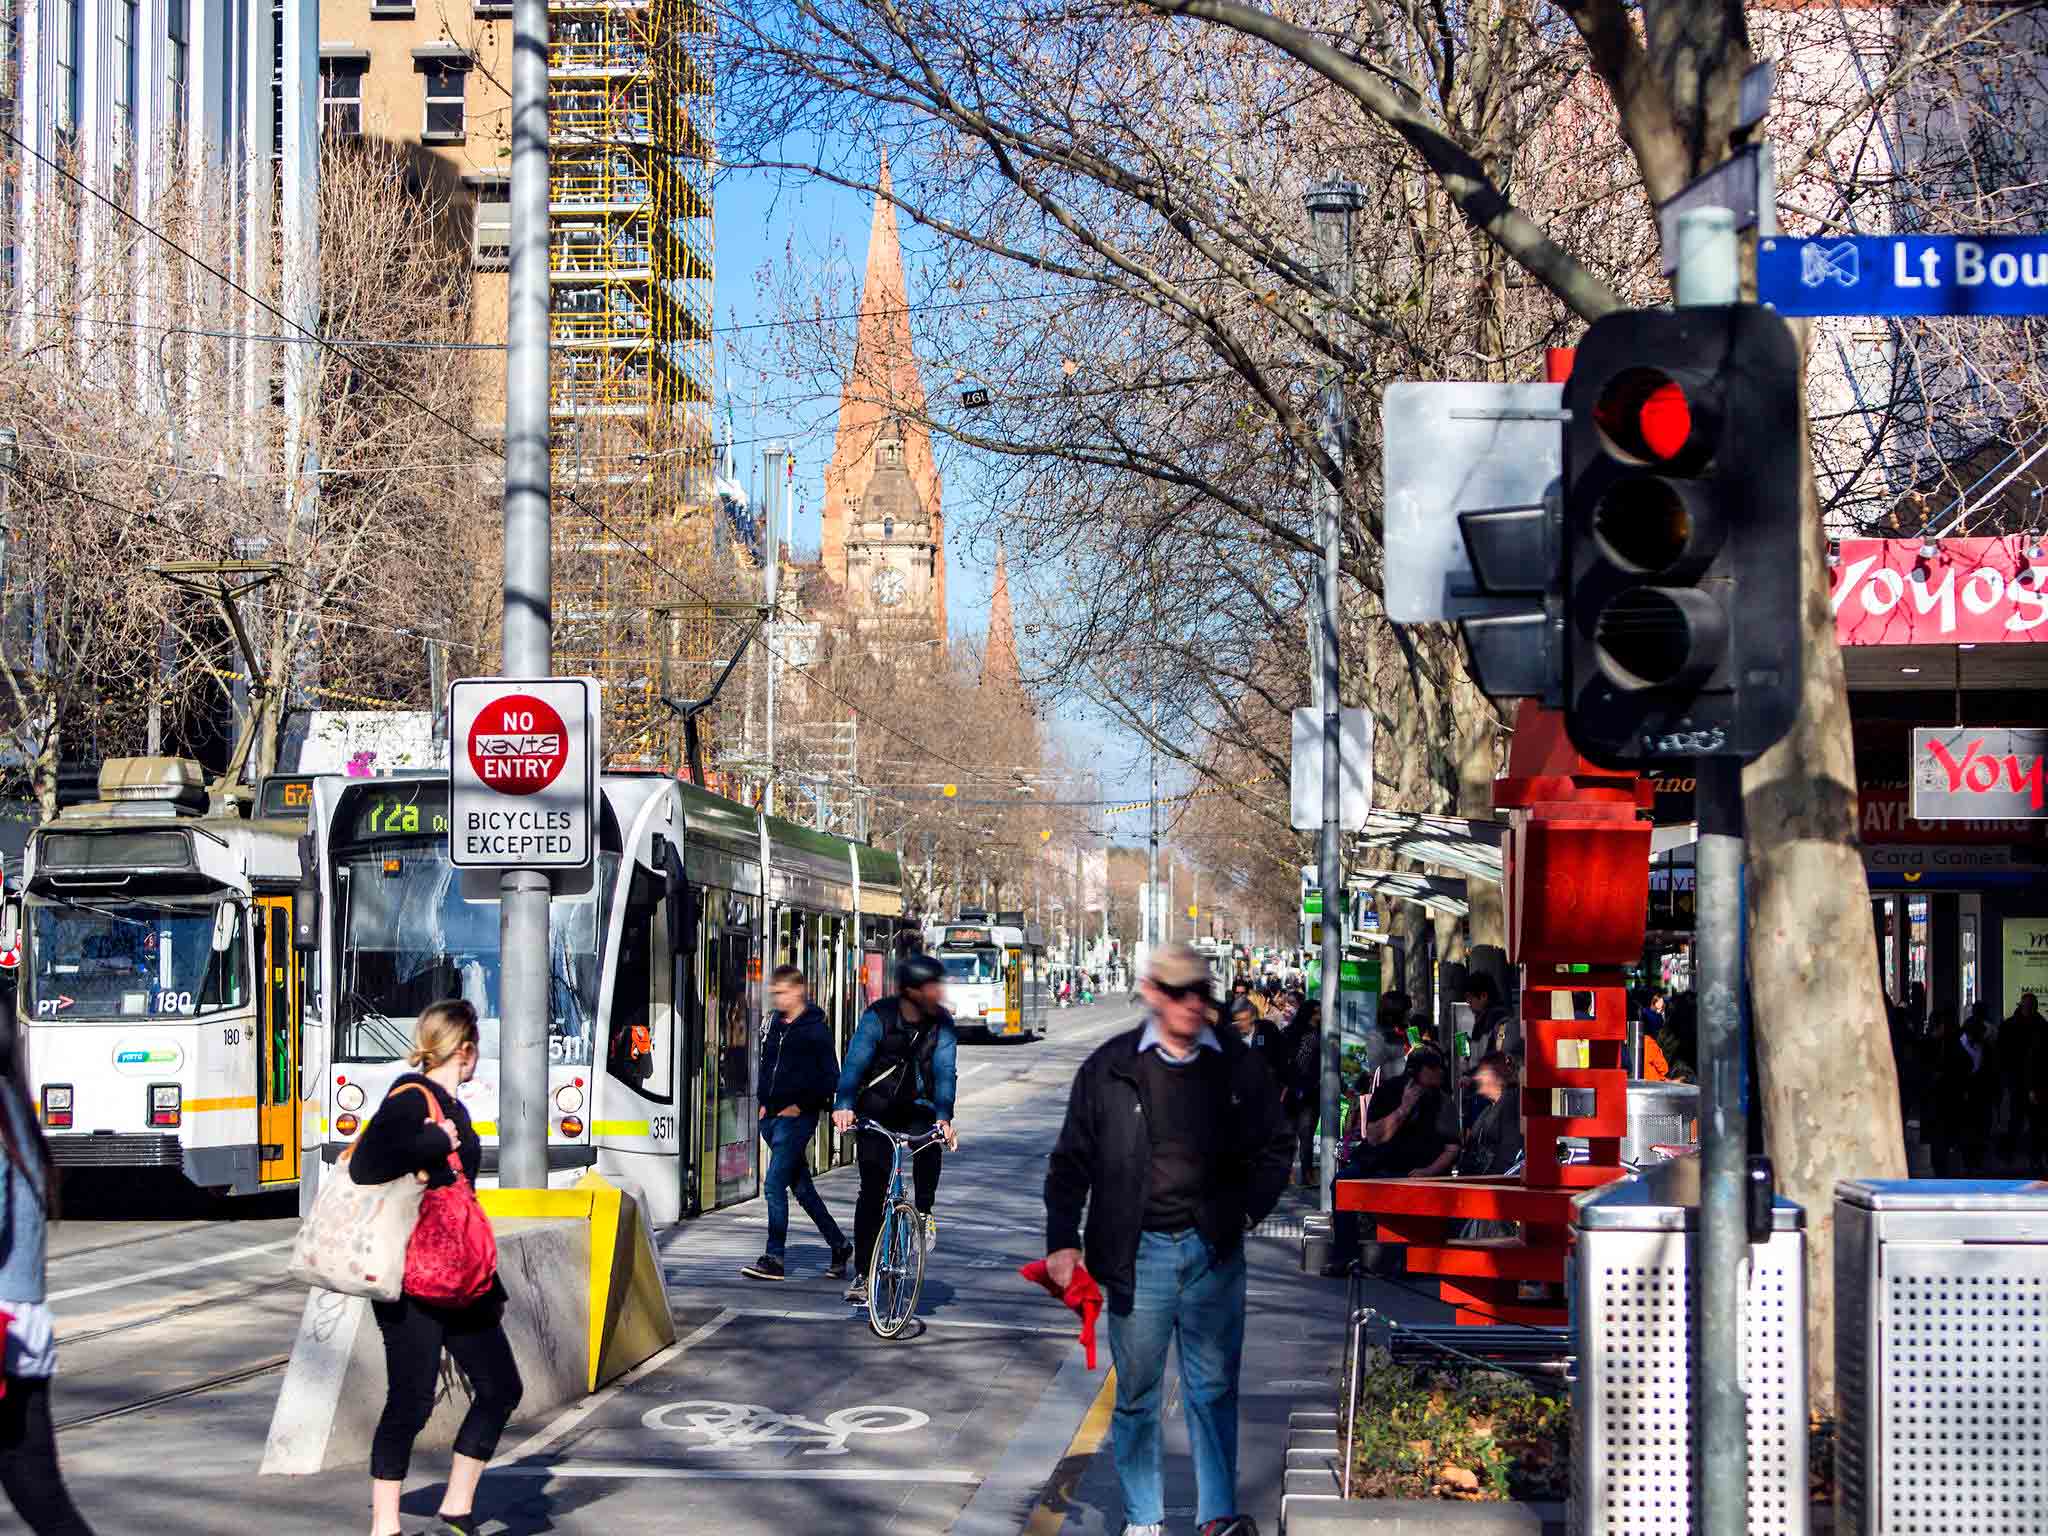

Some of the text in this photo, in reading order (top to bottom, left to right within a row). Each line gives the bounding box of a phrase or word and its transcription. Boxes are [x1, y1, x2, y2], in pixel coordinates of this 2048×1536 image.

[1894, 242, 1941, 287] Lt
[503, 712, 534, 731] NO
[484, 759, 552, 778] ENTRY
[1924, 737, 2048, 811] Yoy
[468, 812, 571, 829] BICYCLES
[467, 837, 571, 853] EXCEPTED
[156, 991, 192, 1013] 180
[223, 1028, 240, 1045] 180
[653, 1116, 674, 1139] 3511
